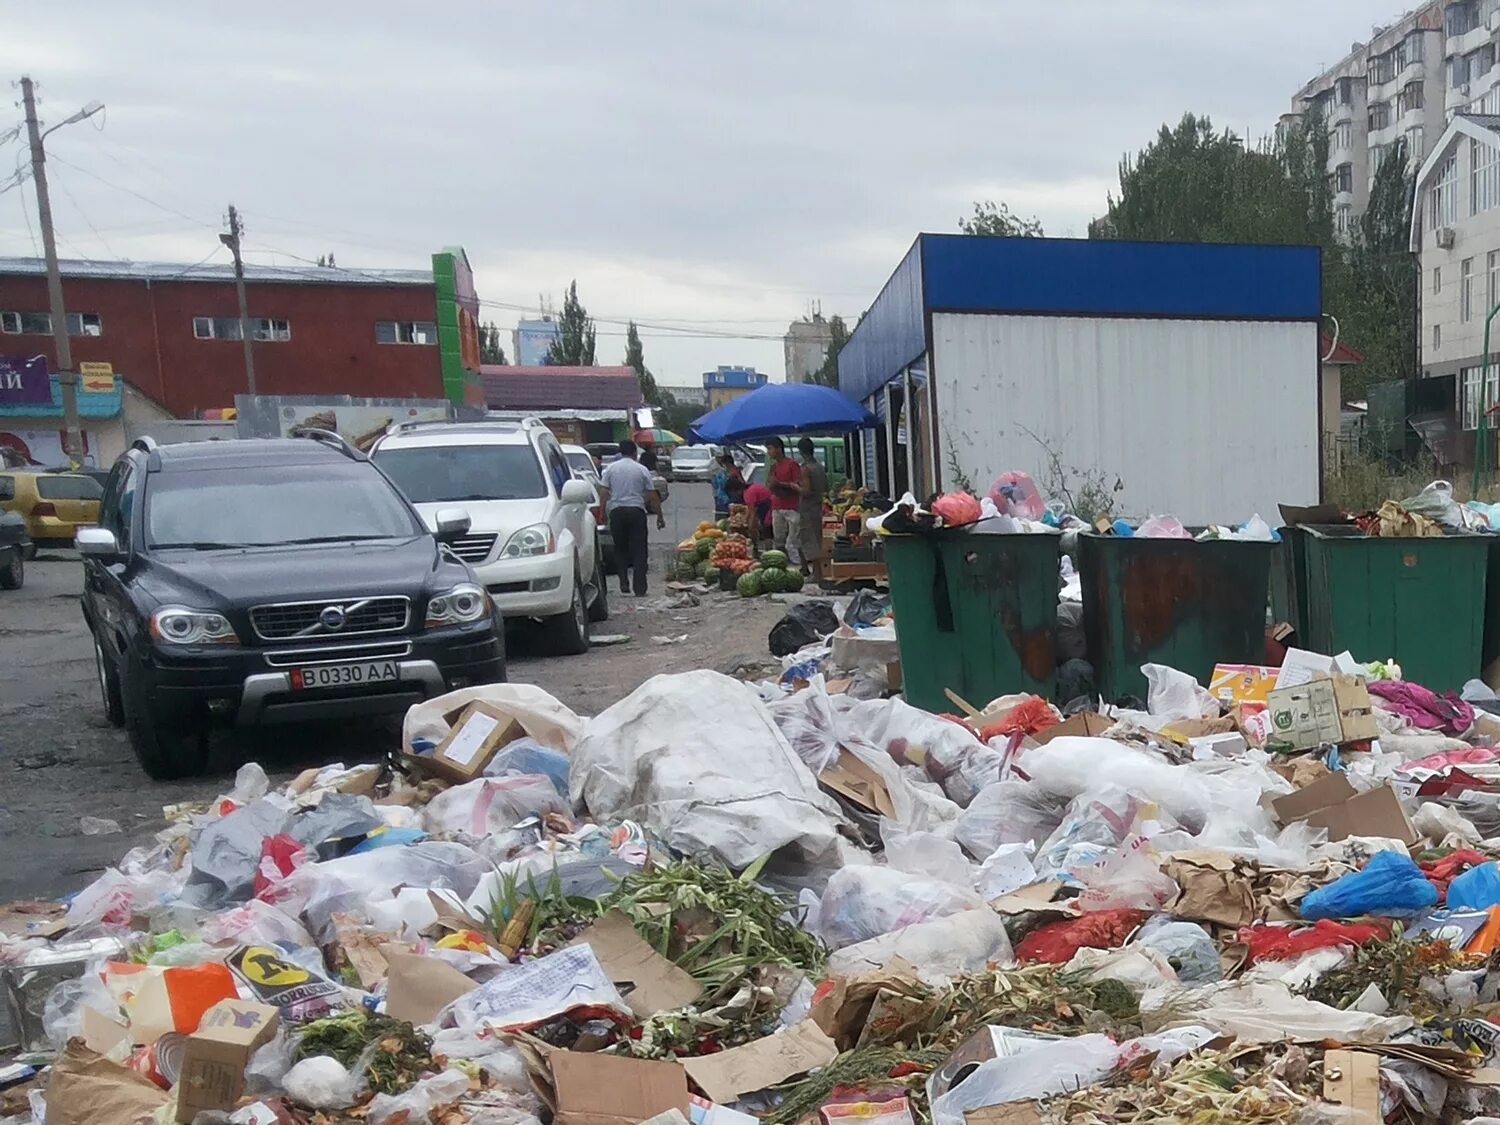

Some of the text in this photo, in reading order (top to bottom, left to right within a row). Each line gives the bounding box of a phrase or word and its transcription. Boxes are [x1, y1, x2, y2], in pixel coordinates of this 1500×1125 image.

[302, 662, 396, 686] B 0330 AA
